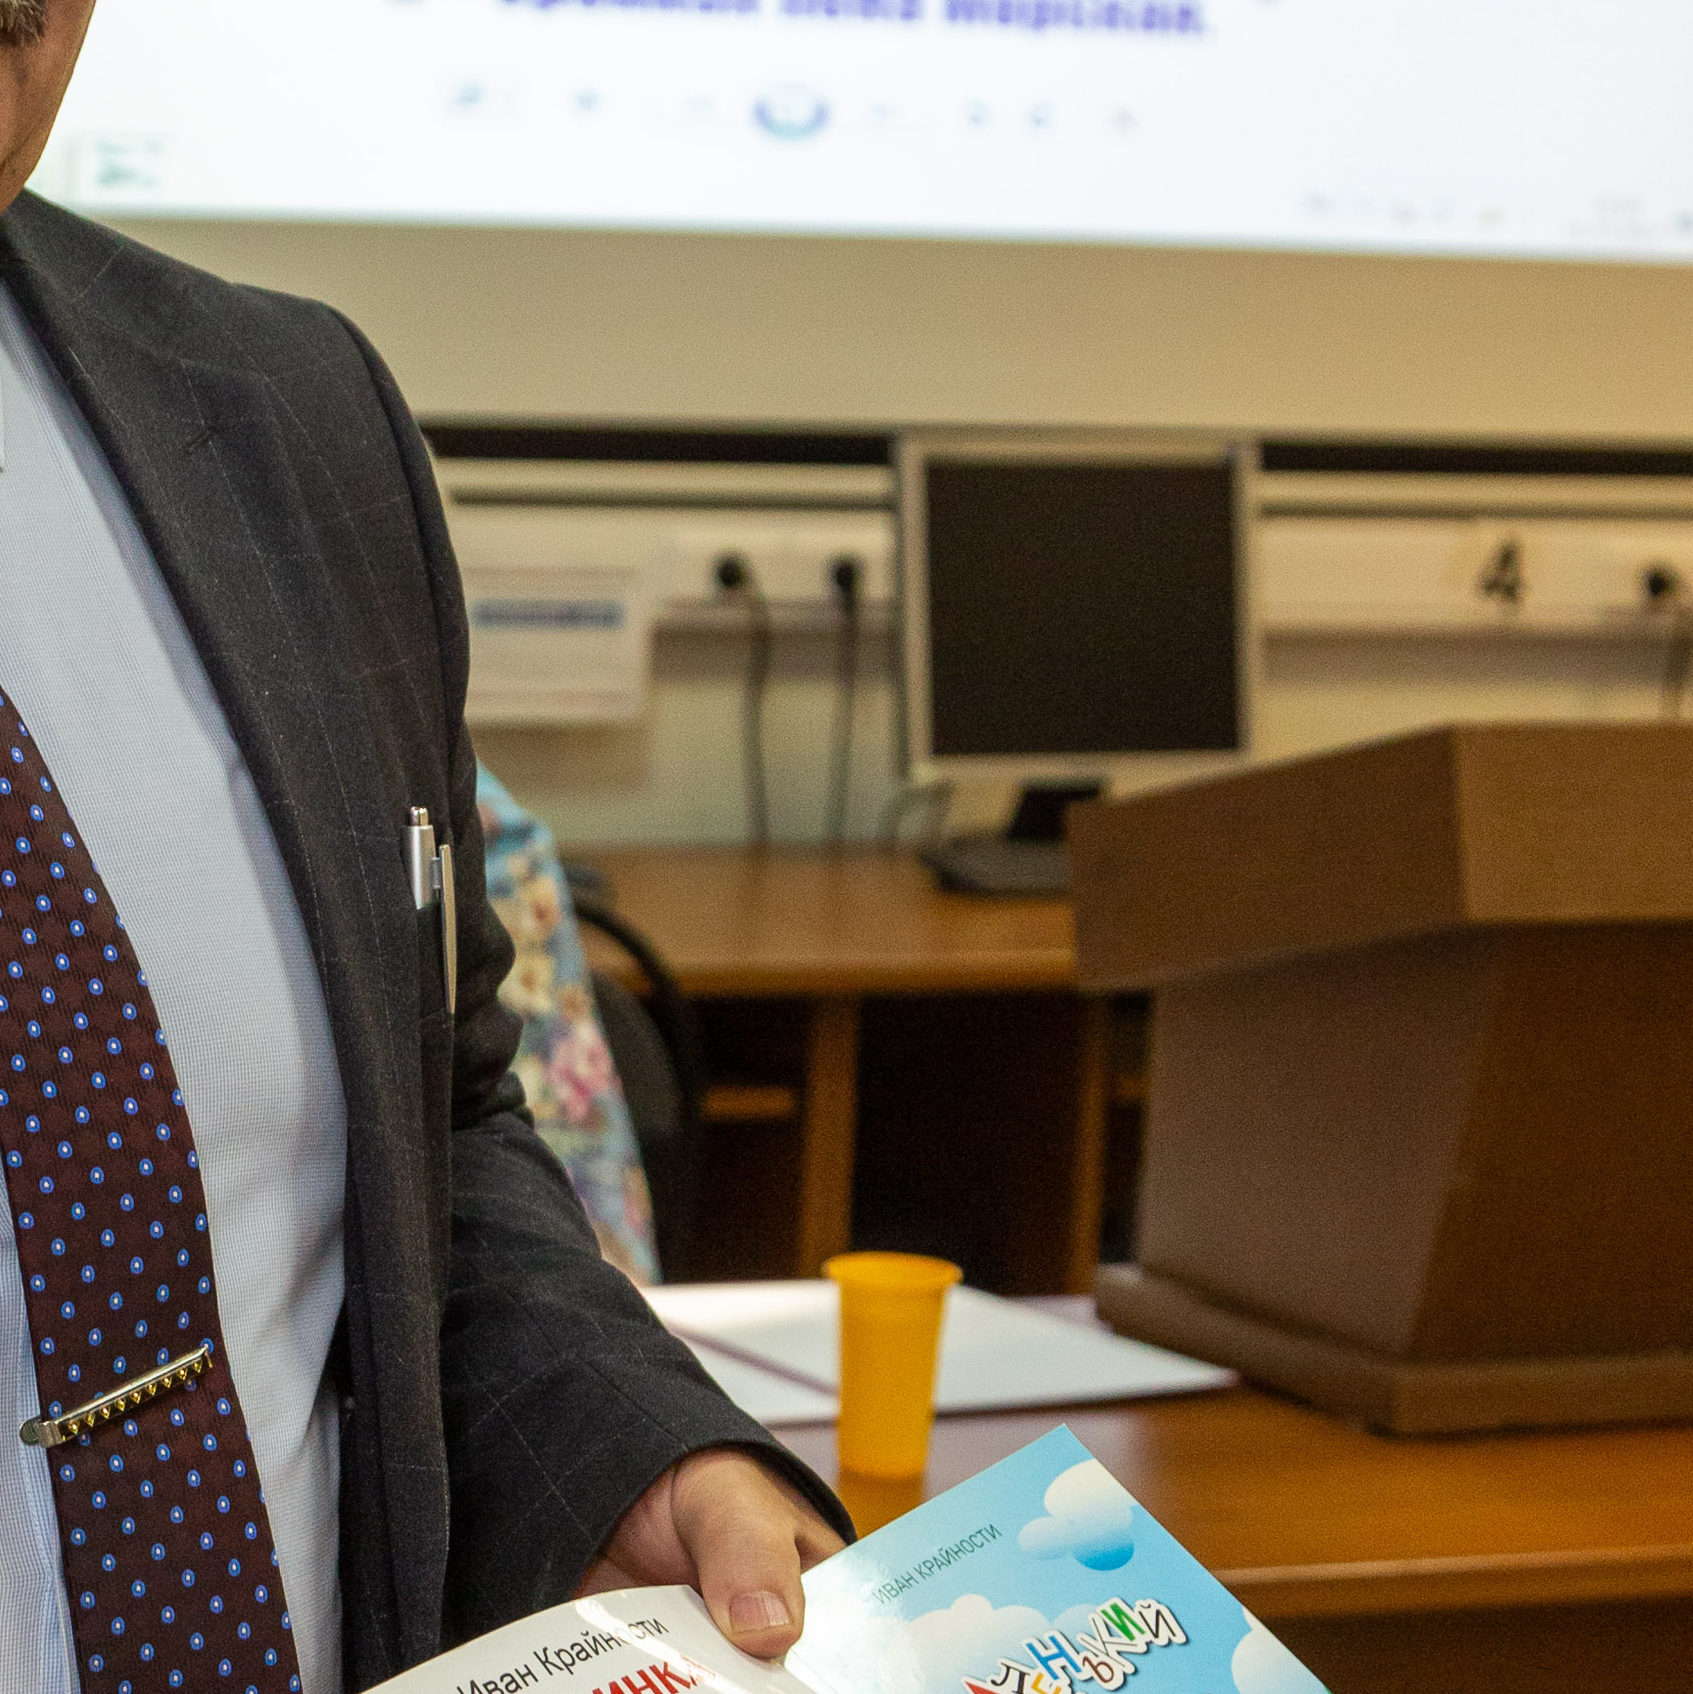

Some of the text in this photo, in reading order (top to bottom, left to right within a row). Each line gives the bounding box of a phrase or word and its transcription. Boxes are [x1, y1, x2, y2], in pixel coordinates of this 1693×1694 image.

[1475, 538, 1523, 605] 4
[871, 1522, 1005, 1606] ИВАН КРАЙНОСТИ
[532, 1615, 671, 1684] Крайности
